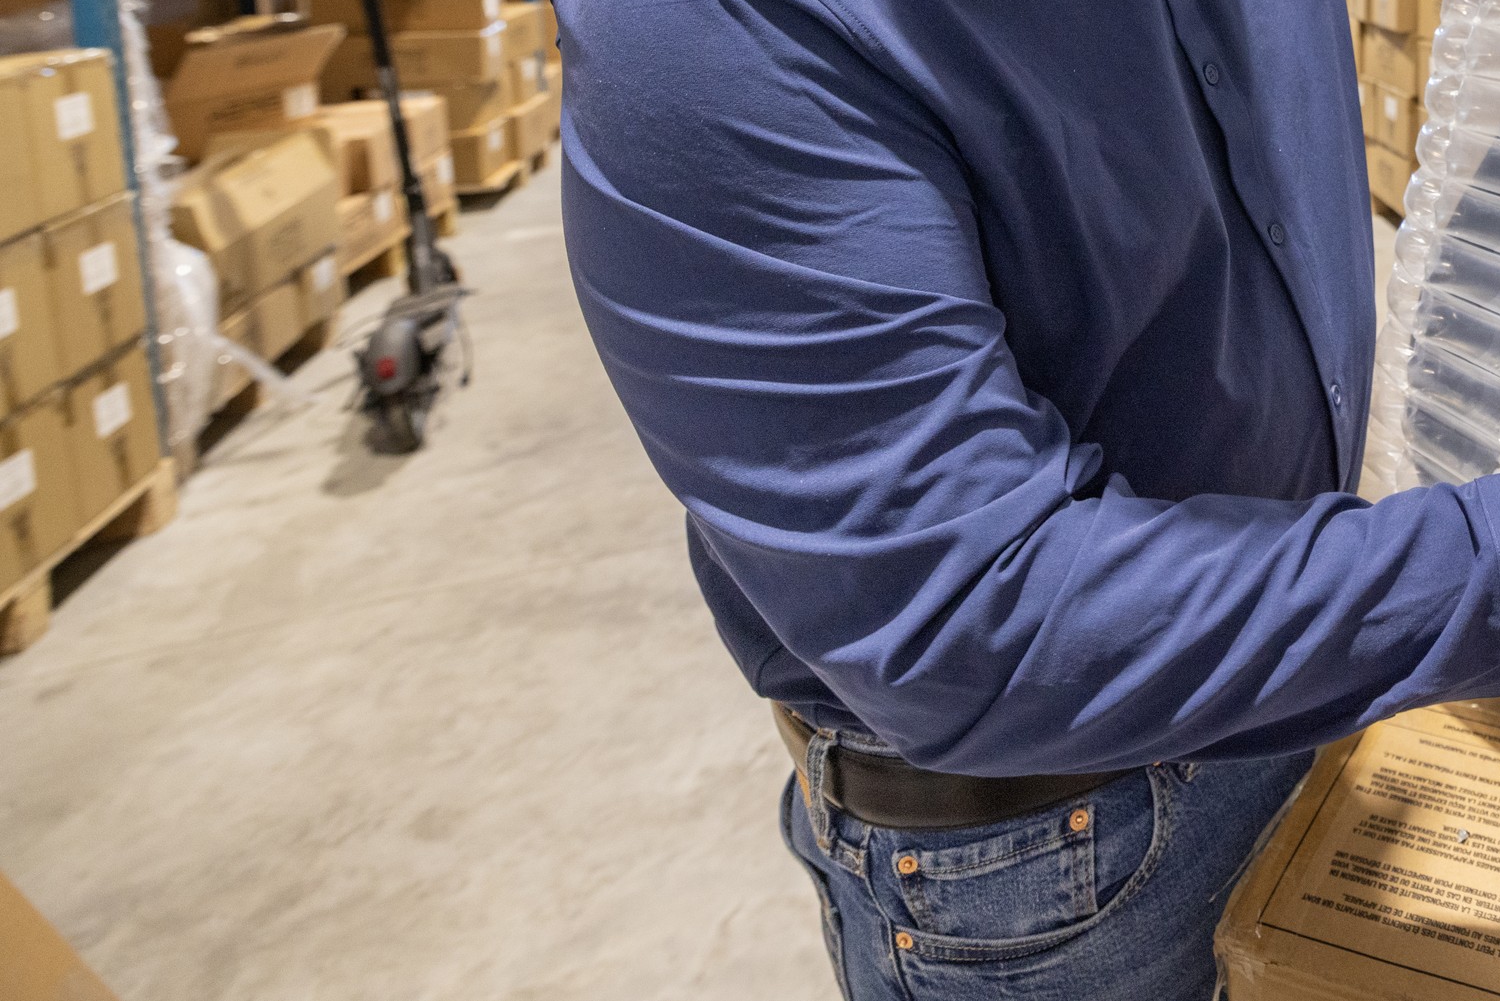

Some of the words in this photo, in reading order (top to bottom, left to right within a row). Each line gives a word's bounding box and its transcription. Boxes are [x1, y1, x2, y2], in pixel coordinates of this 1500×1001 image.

[1416, 835, 1431, 844] UNE
[1431, 839, 1452, 850] FAIRE
[1400, 840, 1415, 850] PAS
[1452, 845, 1472, 855] POUR
[1470, 841, 1485, 849] LES
[1415, 844, 1474, 866] N'APPARAISSENT
[1388, 875, 1399, 883] DE
[1390, 865, 1432, 883] INSPECTION
[1399, 878, 1410, 887] OU
[1410, 881, 1434, 893] PERTE
[1433, 877, 1453, 889] POUR
[1388, 885, 1398, 894] DE
[1434, 888, 1445, 896] DE
[1453, 883, 1497, 901] CONTENEUR
[1445, 891, 1461, 901] CAS
[1461, 895, 1472, 904] EN
[1377, 903, 1392, 914] CET
[1392, 908, 1403, 917] DE
[1460, 906, 1471, 915] LA
[1404, 911, 1470, 937] FONCTIONNEMENT
[1420, 927, 1436, 938] DES
[1470, 930, 1482, 940] AU
[1436, 932, 1475, 949] CONTENIR
[1475, 943, 1496, 956] PEUT
